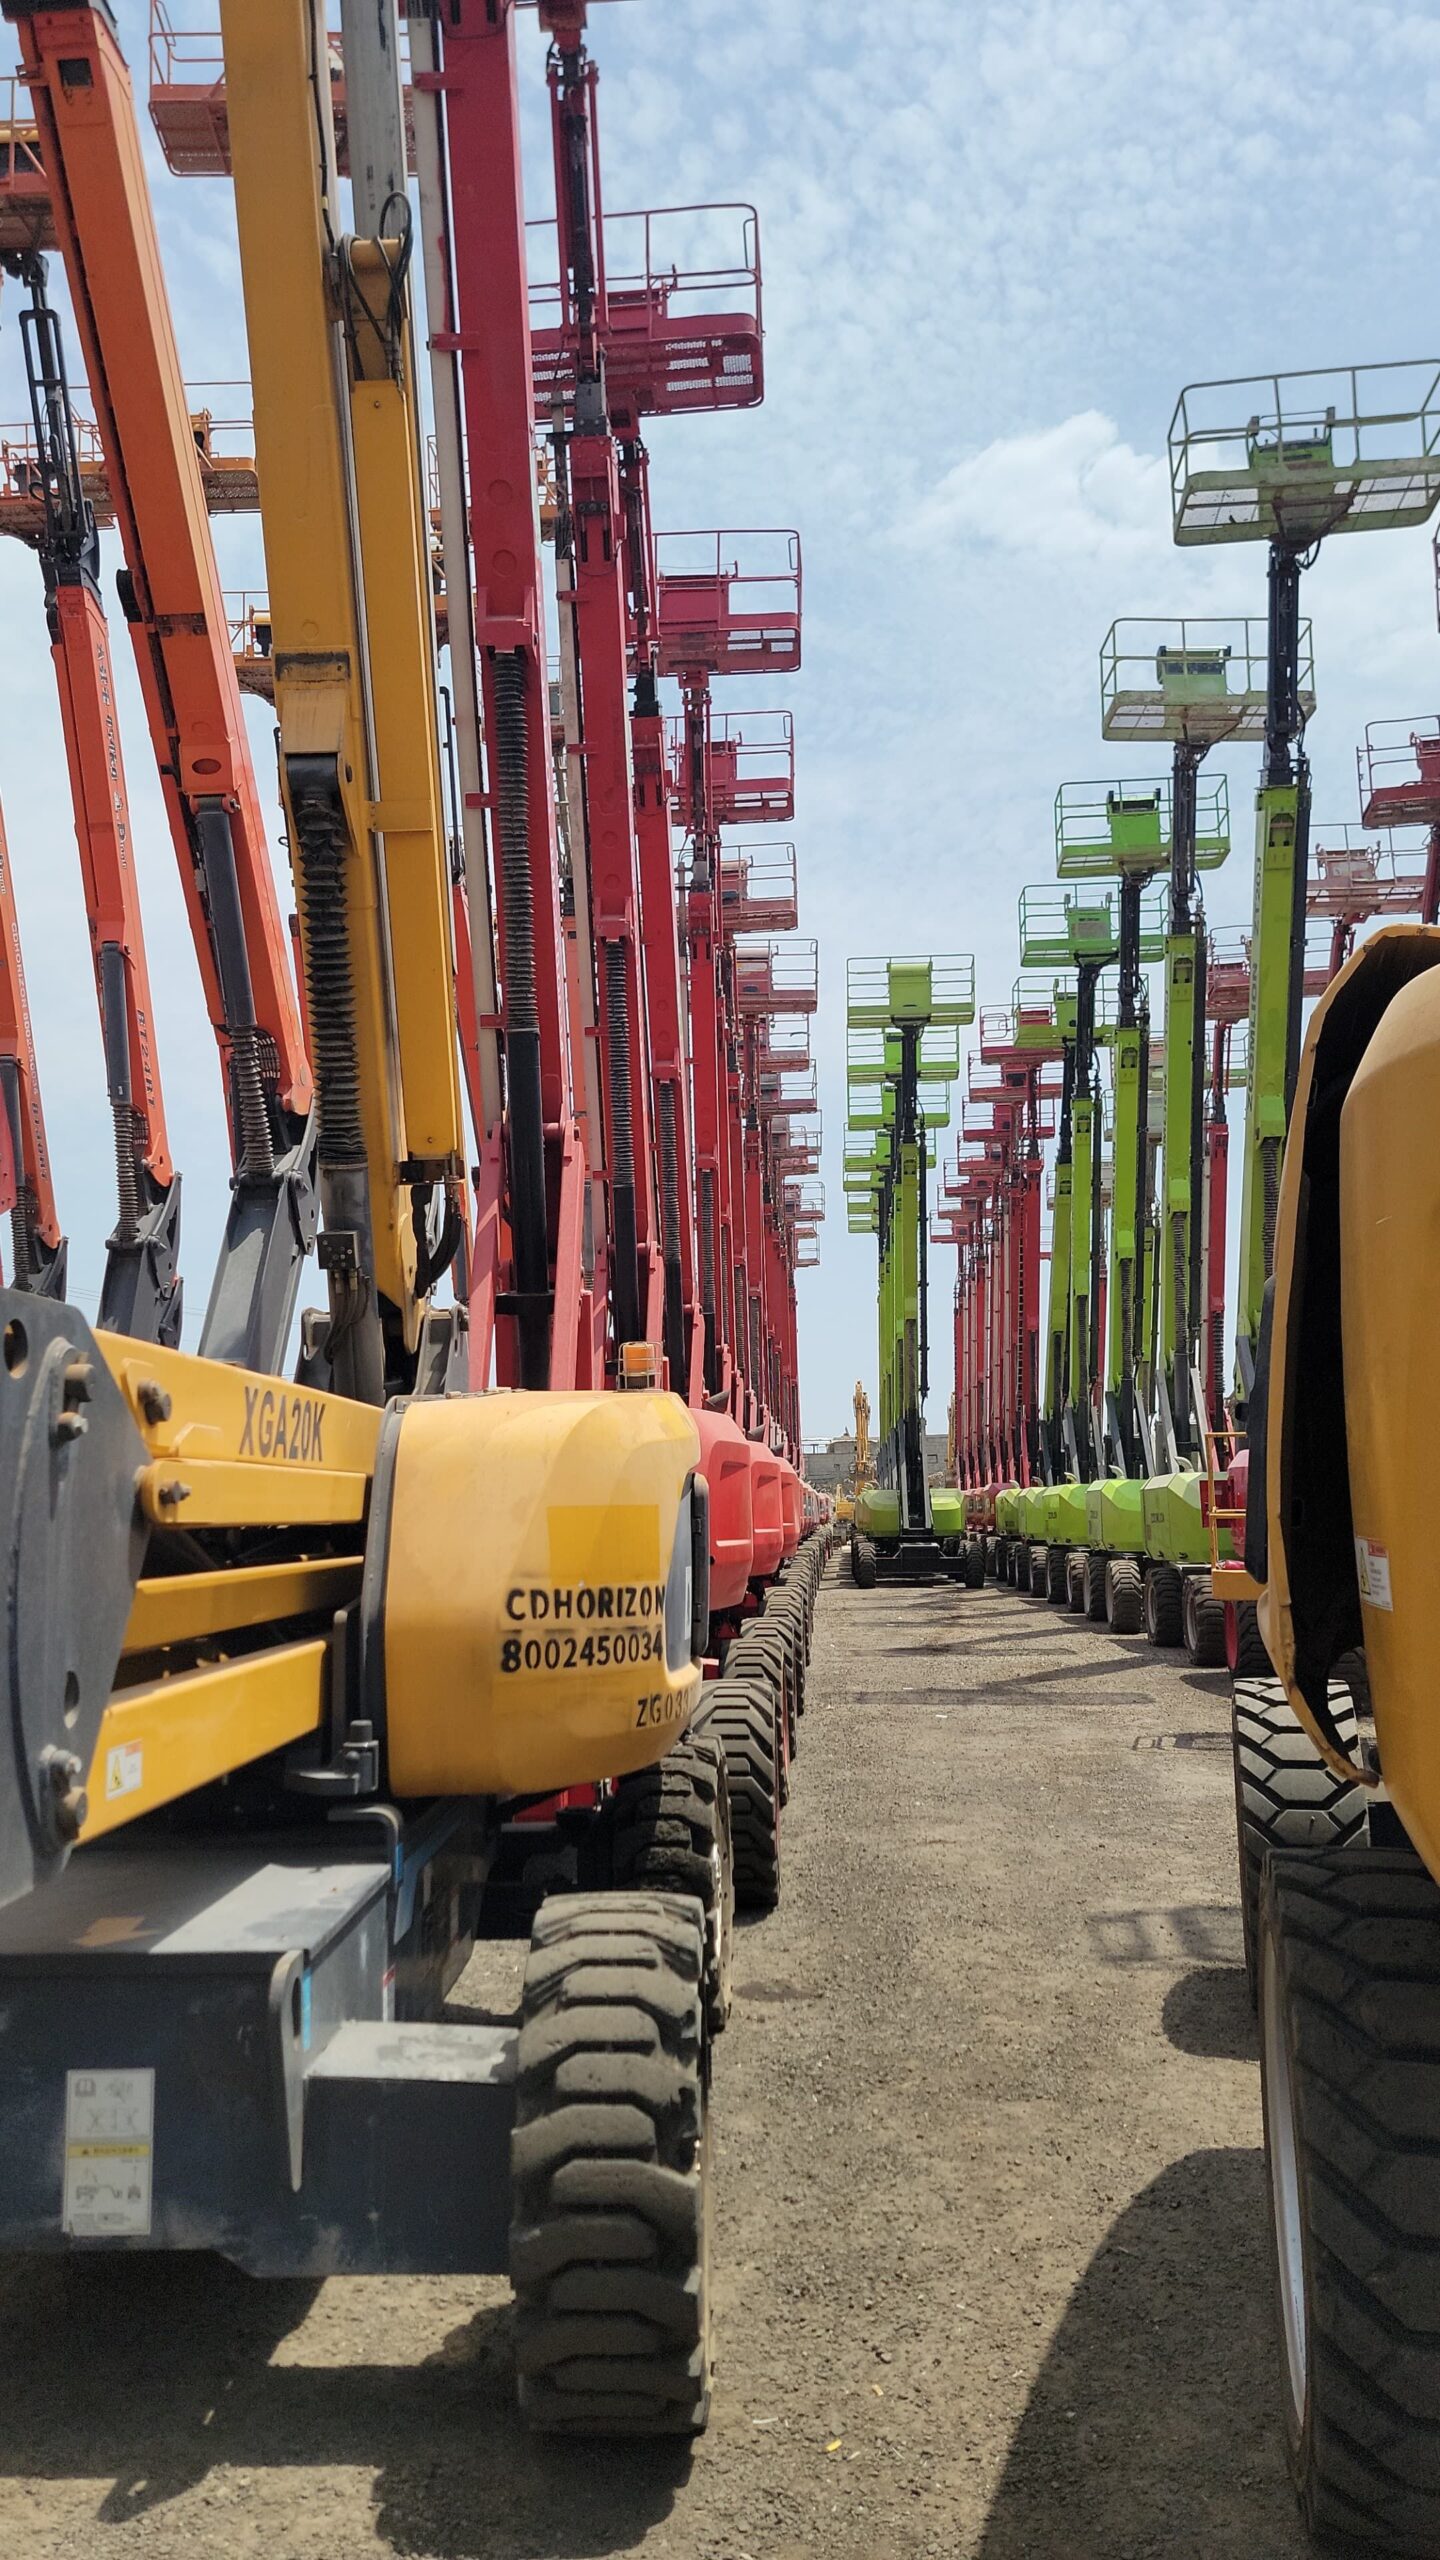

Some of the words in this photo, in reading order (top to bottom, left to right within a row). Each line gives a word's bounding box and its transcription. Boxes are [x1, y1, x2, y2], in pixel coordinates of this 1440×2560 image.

[239, 1386, 326, 1461] XGA20K
[506, 1585, 665, 1620] CDHORIZON
[501, 1630, 664, 1673] 8002450034
[636, 1687, 693, 1728] ZG033
